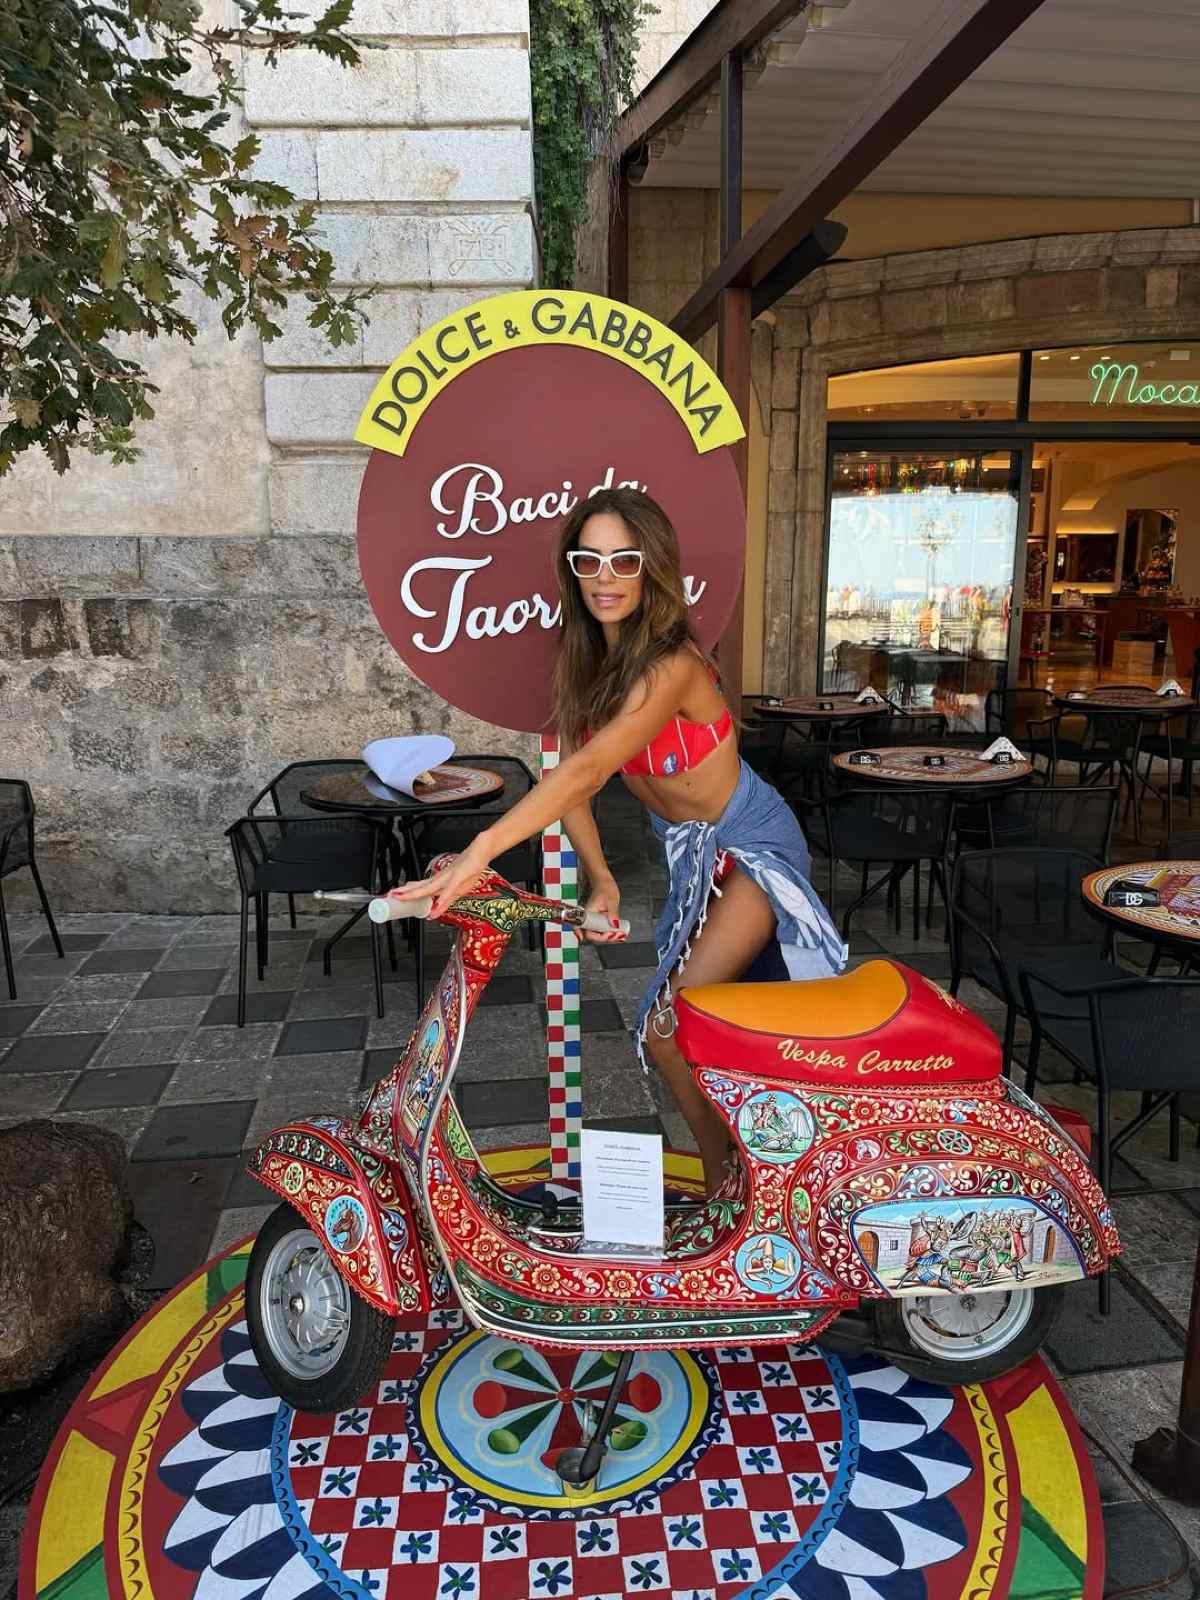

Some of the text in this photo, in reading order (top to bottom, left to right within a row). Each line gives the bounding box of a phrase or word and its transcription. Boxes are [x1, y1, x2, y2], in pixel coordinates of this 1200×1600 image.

[371, 297, 723, 436] DOLCE & GABBANA
[430, 463, 577, 539] Baci
[1125, 892, 1143, 906] DG
[777, 1039, 954, 1075] Vespa Carretto
